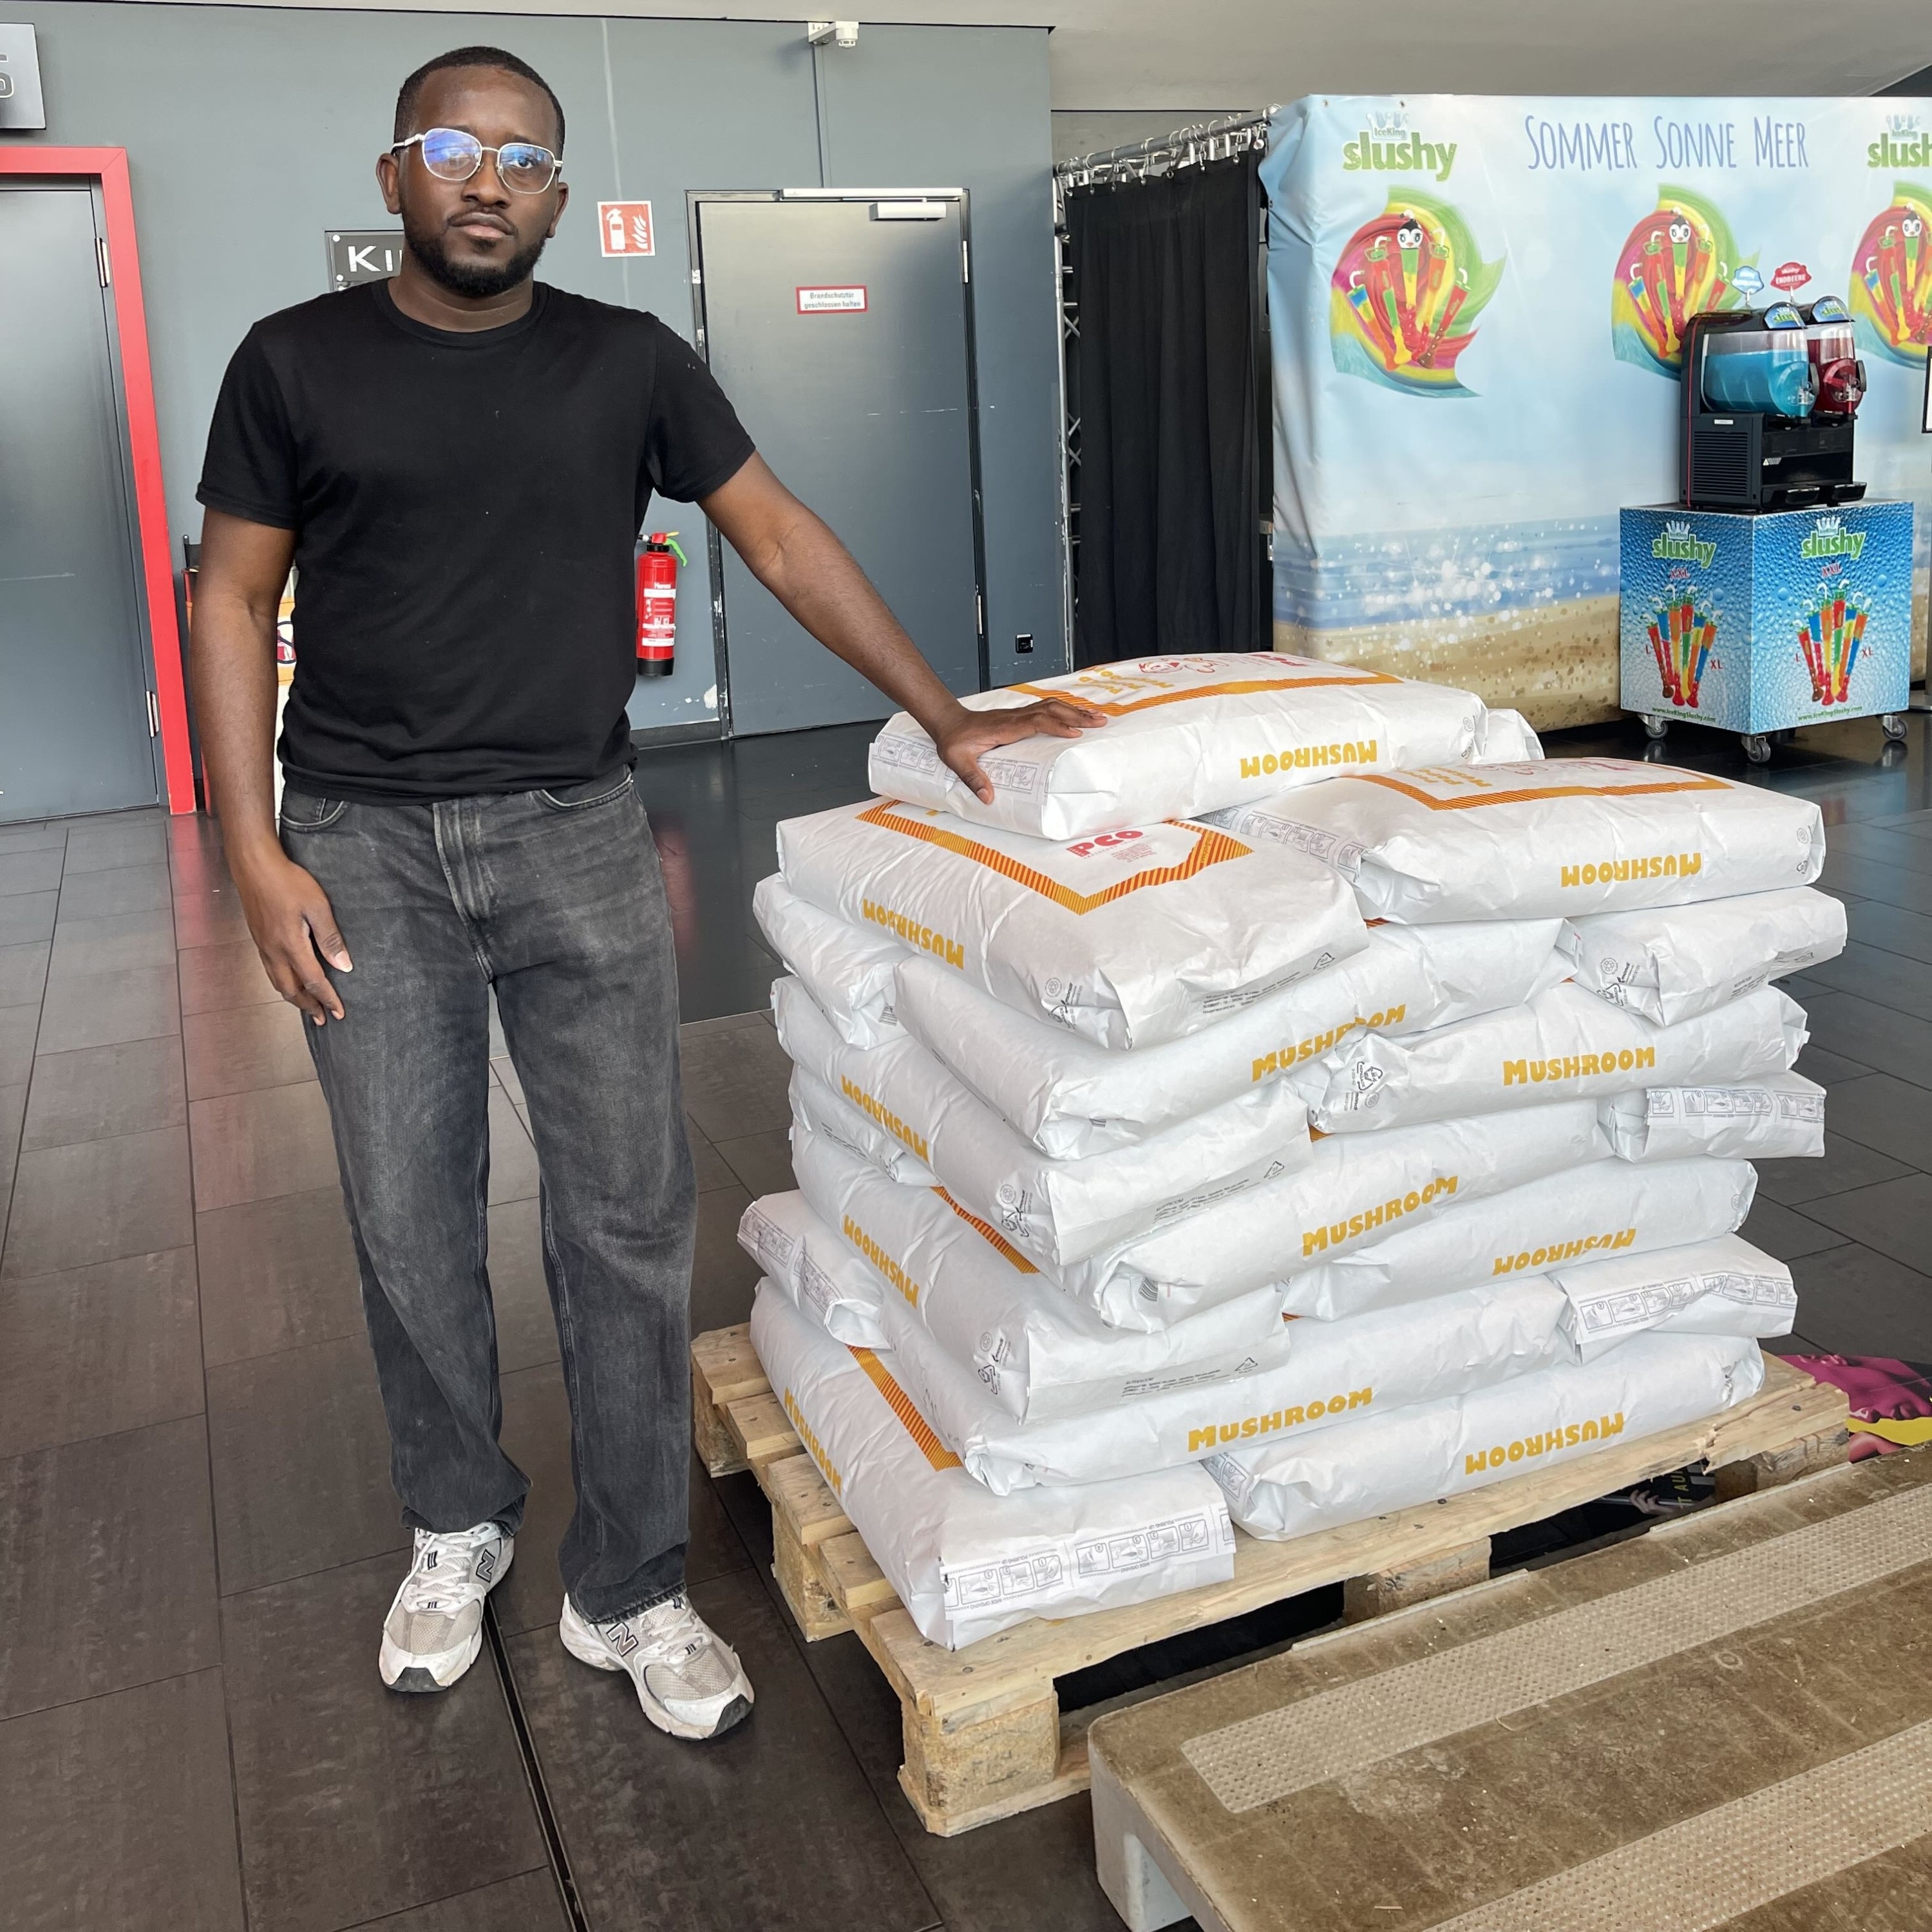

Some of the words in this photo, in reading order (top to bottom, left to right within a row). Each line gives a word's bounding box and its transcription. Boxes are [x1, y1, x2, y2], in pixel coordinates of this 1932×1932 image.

[1374, 127, 1406, 138] IceKing
[1524, 114, 1638, 172] SOMMER
[1653, 115, 1738, 170] SONNE
[1753, 115, 1810, 169] MEER
[1342, 131, 1458, 182] slushy
[347, 245, 402, 272] KI
[804, 301, 842, 310] geschlossen
[1652, 533, 1716, 569] slushy
[1801, 528, 1865, 560] slushy
[1710, 659, 1723, 670] XL
[1861, 646, 1873, 658] XL
[1240, 740, 1377, 779] MUSHROOM
[1066, 830, 1144, 857] PCO
[1561, 852, 1701, 887] MUSHROOM
[1503, 1046, 1656, 1086] MUSHROOM
[841, 1074, 929, 1164] MUSHROOM
[1302, 1175, 1459, 1257] MUSHROOM
[844, 1214, 920, 1309] MUSHROOM
[1492, 1228, 1637, 1276] MUSHROOM
[1188, 1387, 1373, 1453] MUSHROOM
[1464, 1412, 1625, 1475] MUSHROOM
